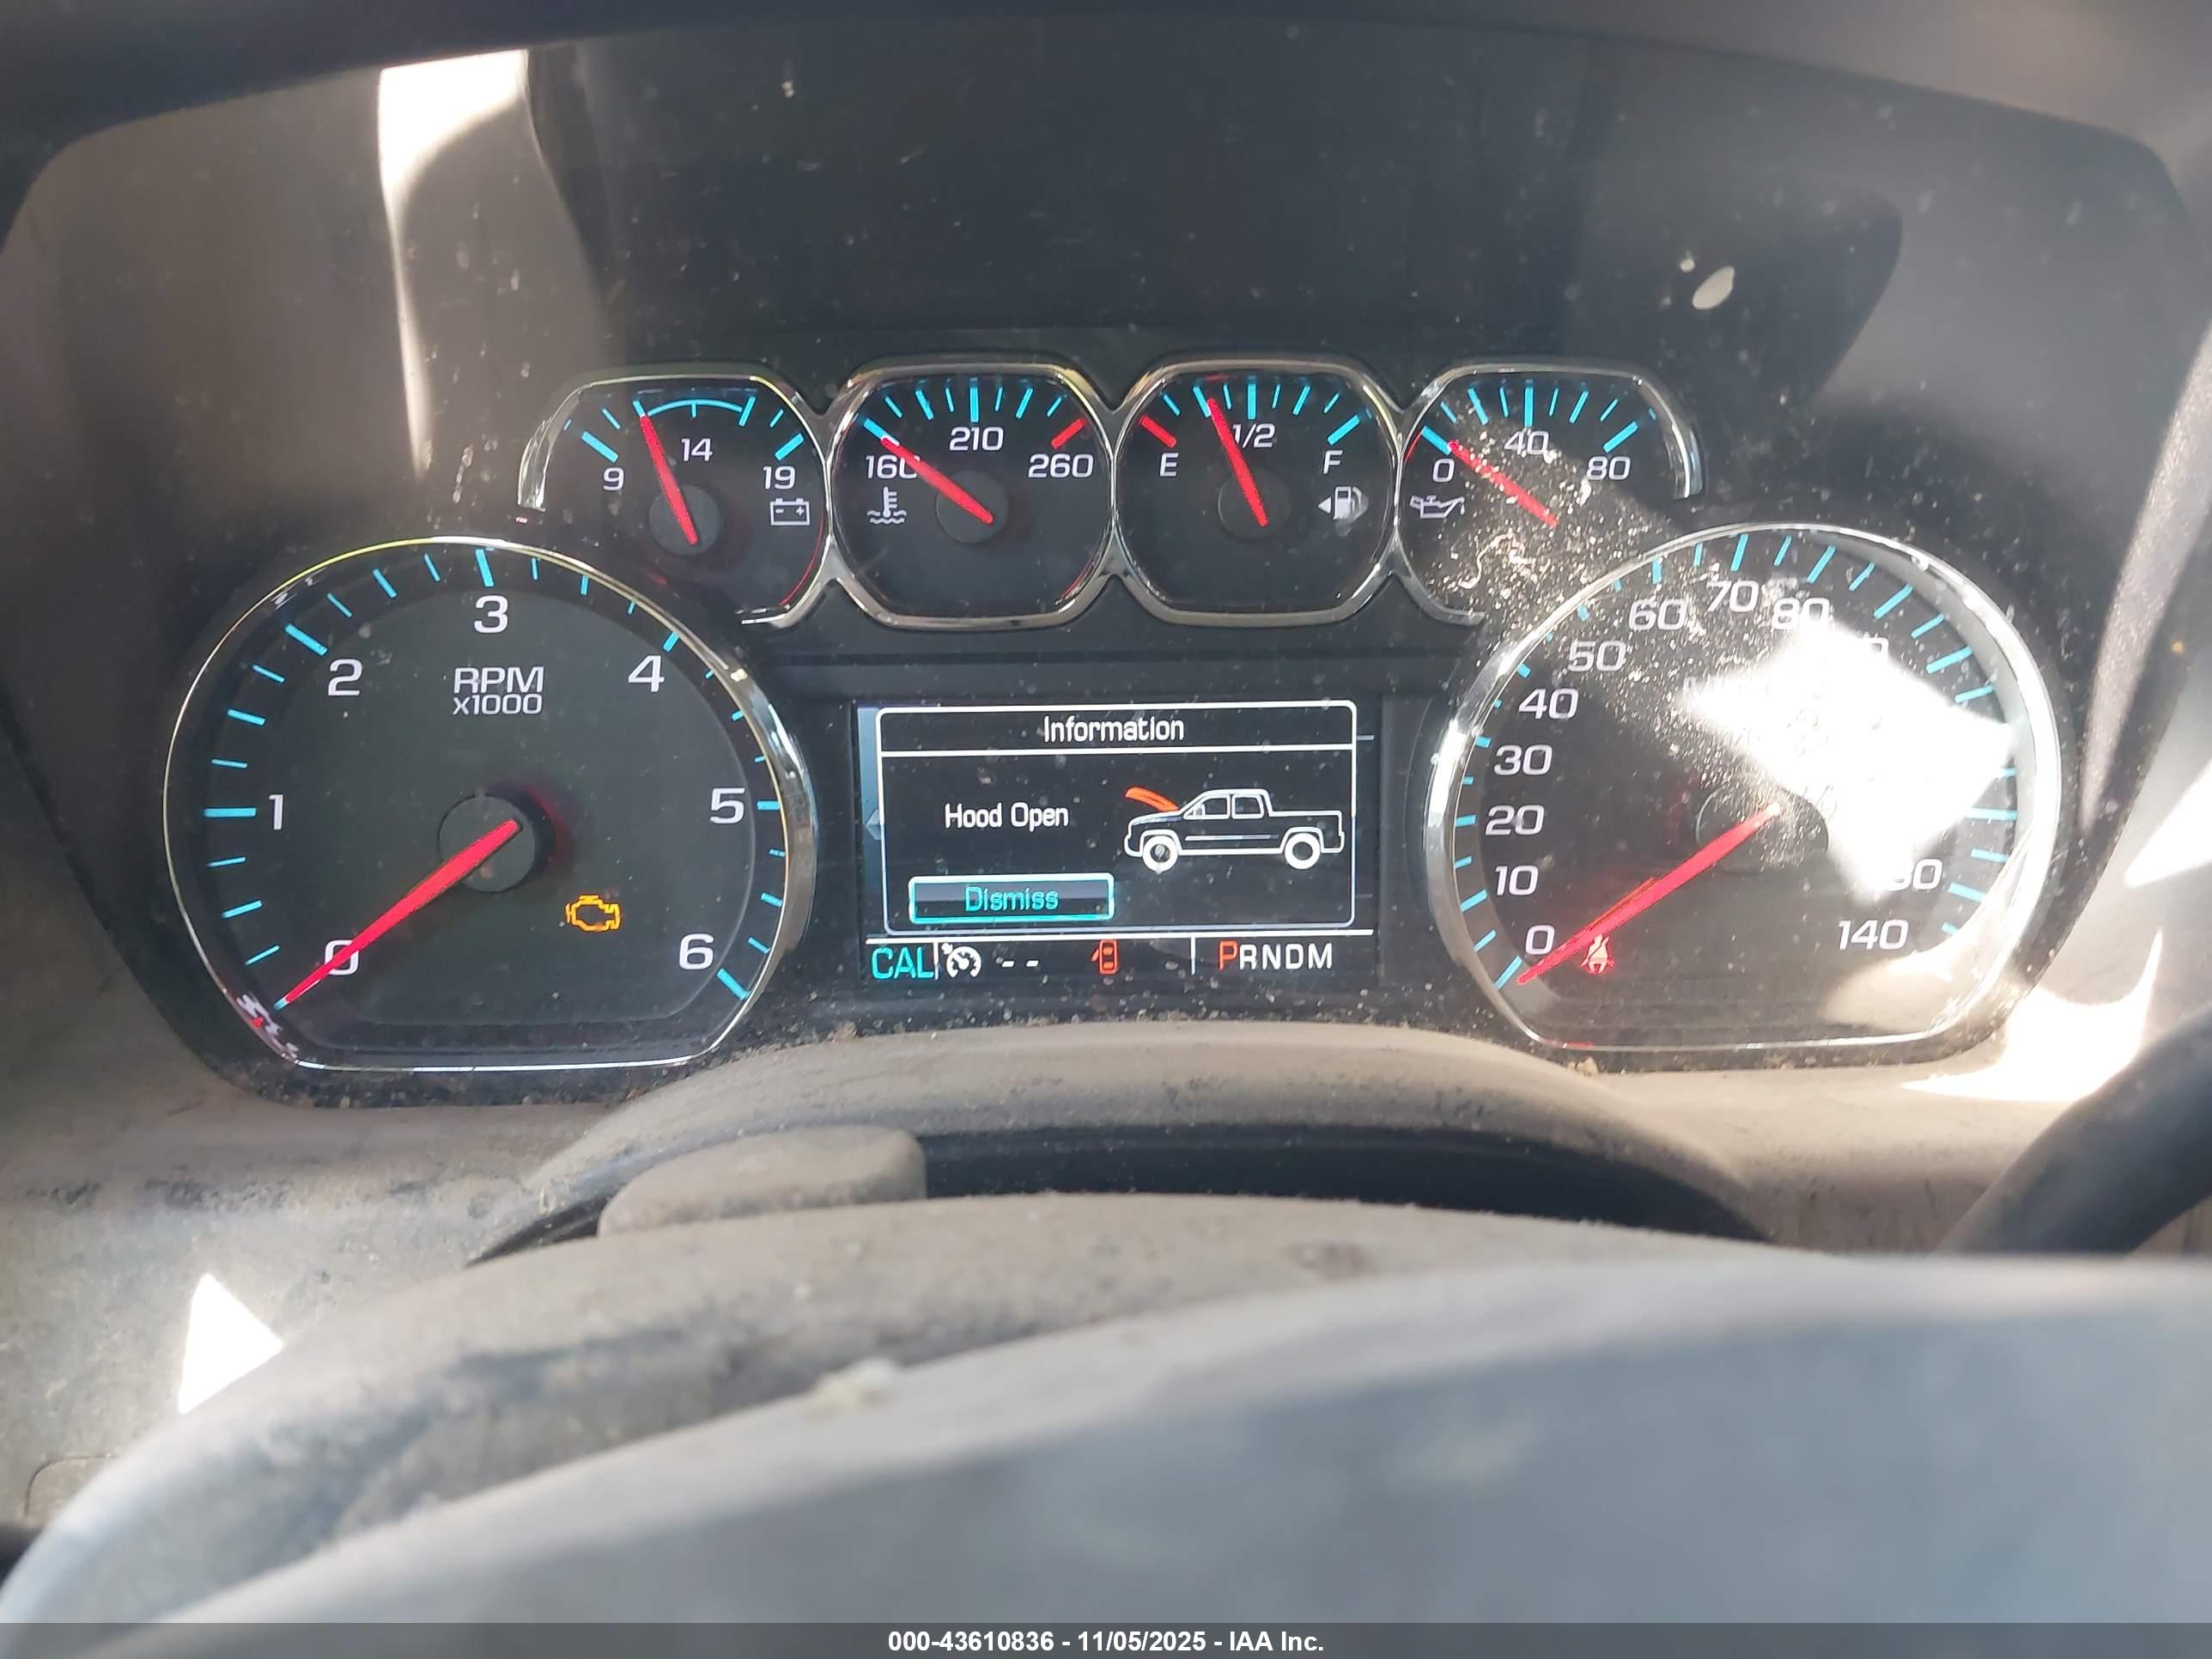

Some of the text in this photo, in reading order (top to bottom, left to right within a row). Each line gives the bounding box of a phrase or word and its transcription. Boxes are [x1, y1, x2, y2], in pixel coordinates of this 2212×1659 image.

[681, 437, 714, 460] 14
[950, 426, 1004, 452] 210
[1504, 430, 1550, 455] 40
[763, 465, 797, 489] 19
[1030, 453, 1093, 479] 260
[1161, 453, 1179, 477] E
[1323, 451, 1343, 474] F
[1432, 459, 1455, 483] 0
[1586, 455, 1632, 481] 80
[603, 467, 625, 491] 9
[1709, 580, 1759, 612] 70
[473, 596, 509, 635] 3
[1628, 601, 1689, 630] 60
[1568, 640, 1628, 673] 50
[326, 658, 362, 696] 2
[453, 666, 544, 694] RPM
[628, 655, 665, 693] 4
[453, 695, 543, 715] x1000
[1518, 688, 1578, 720] 40
[1042, 715, 1185, 744] Information
[1493, 744, 1553, 775] 30
[269, 795, 285, 830] 1
[709, 787, 745, 824] 5
[945, 802, 1069, 831] Hood Open
[1486, 805, 1545, 836] 20
[1495, 865, 1539, 896] 10
[964, 884, 1059, 912] Dismiss
[1525, 926, 1555, 955] 0
[1838, 920, 1909, 951] 140
[324, 939, 360, 976] 0
[678, 933, 715, 971] 6
[871, 947, 934, 981] CAL
